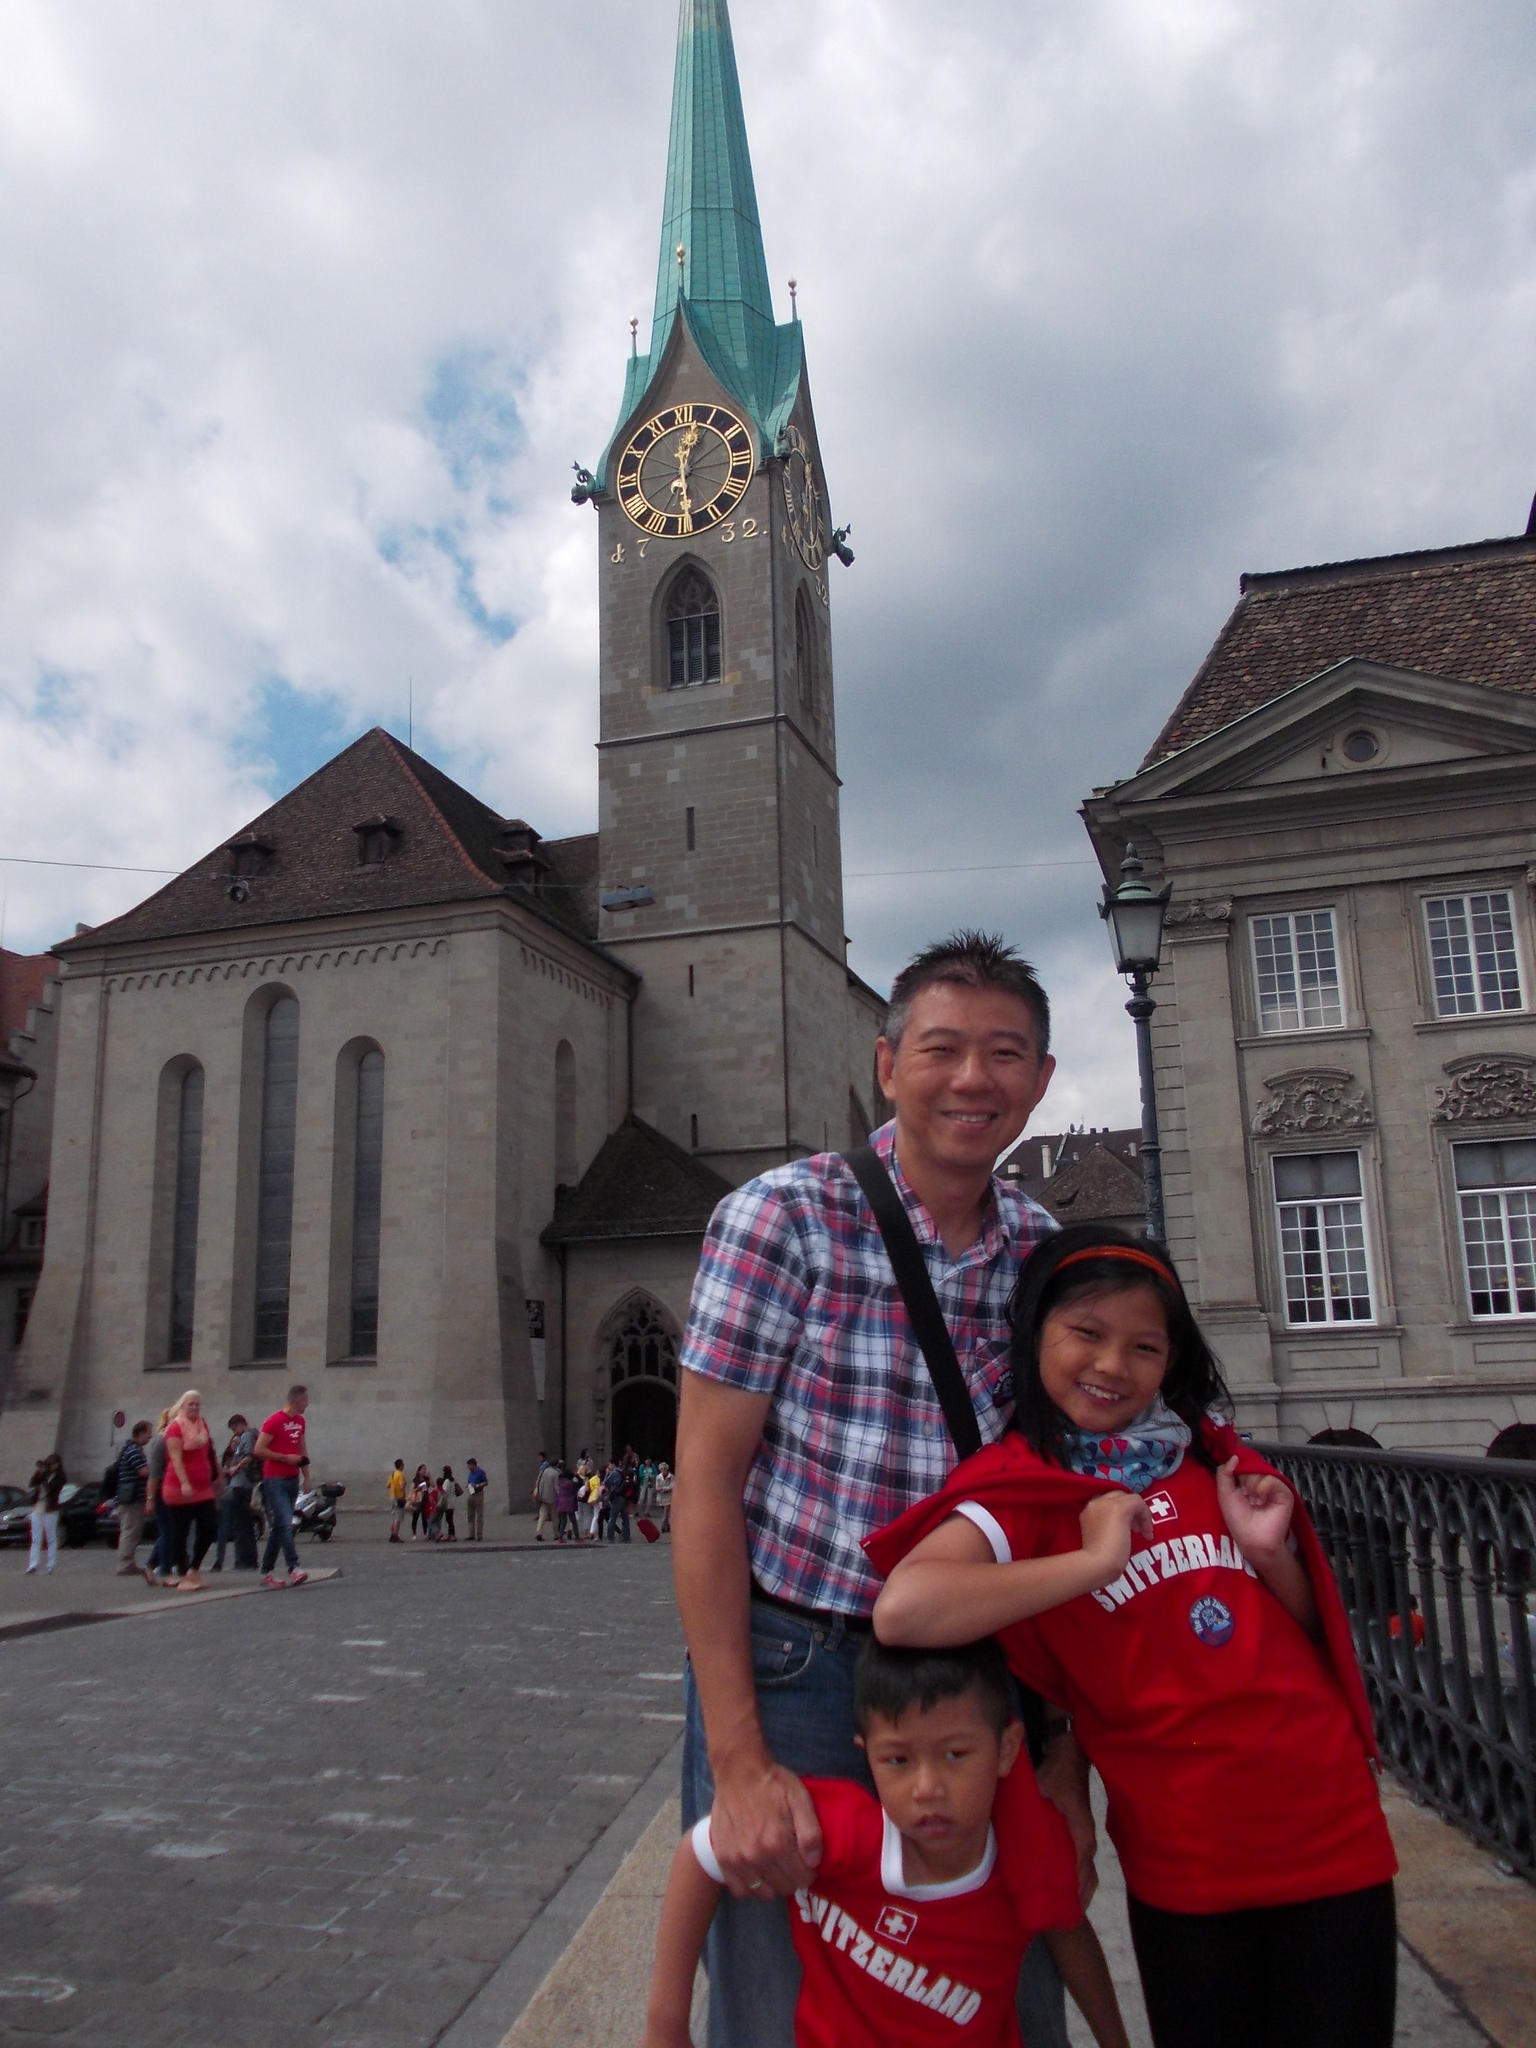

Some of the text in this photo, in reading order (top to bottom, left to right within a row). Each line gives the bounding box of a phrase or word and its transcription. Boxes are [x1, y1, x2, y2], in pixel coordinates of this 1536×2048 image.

[674, 405, 693, 426] XII
[706, 409, 717, 425] I
[646, 418, 665, 438] XI
[724, 423, 742, 440] II
[626, 445, 644, 459] X
[732, 450, 751, 466] III
[619, 472, 637, 488] IX
[723, 477, 746, 499] IIII
[1090, 1533, 1258, 1613] SWITZERLA
[794, 1887, 982, 2026] SWITZERLAND
